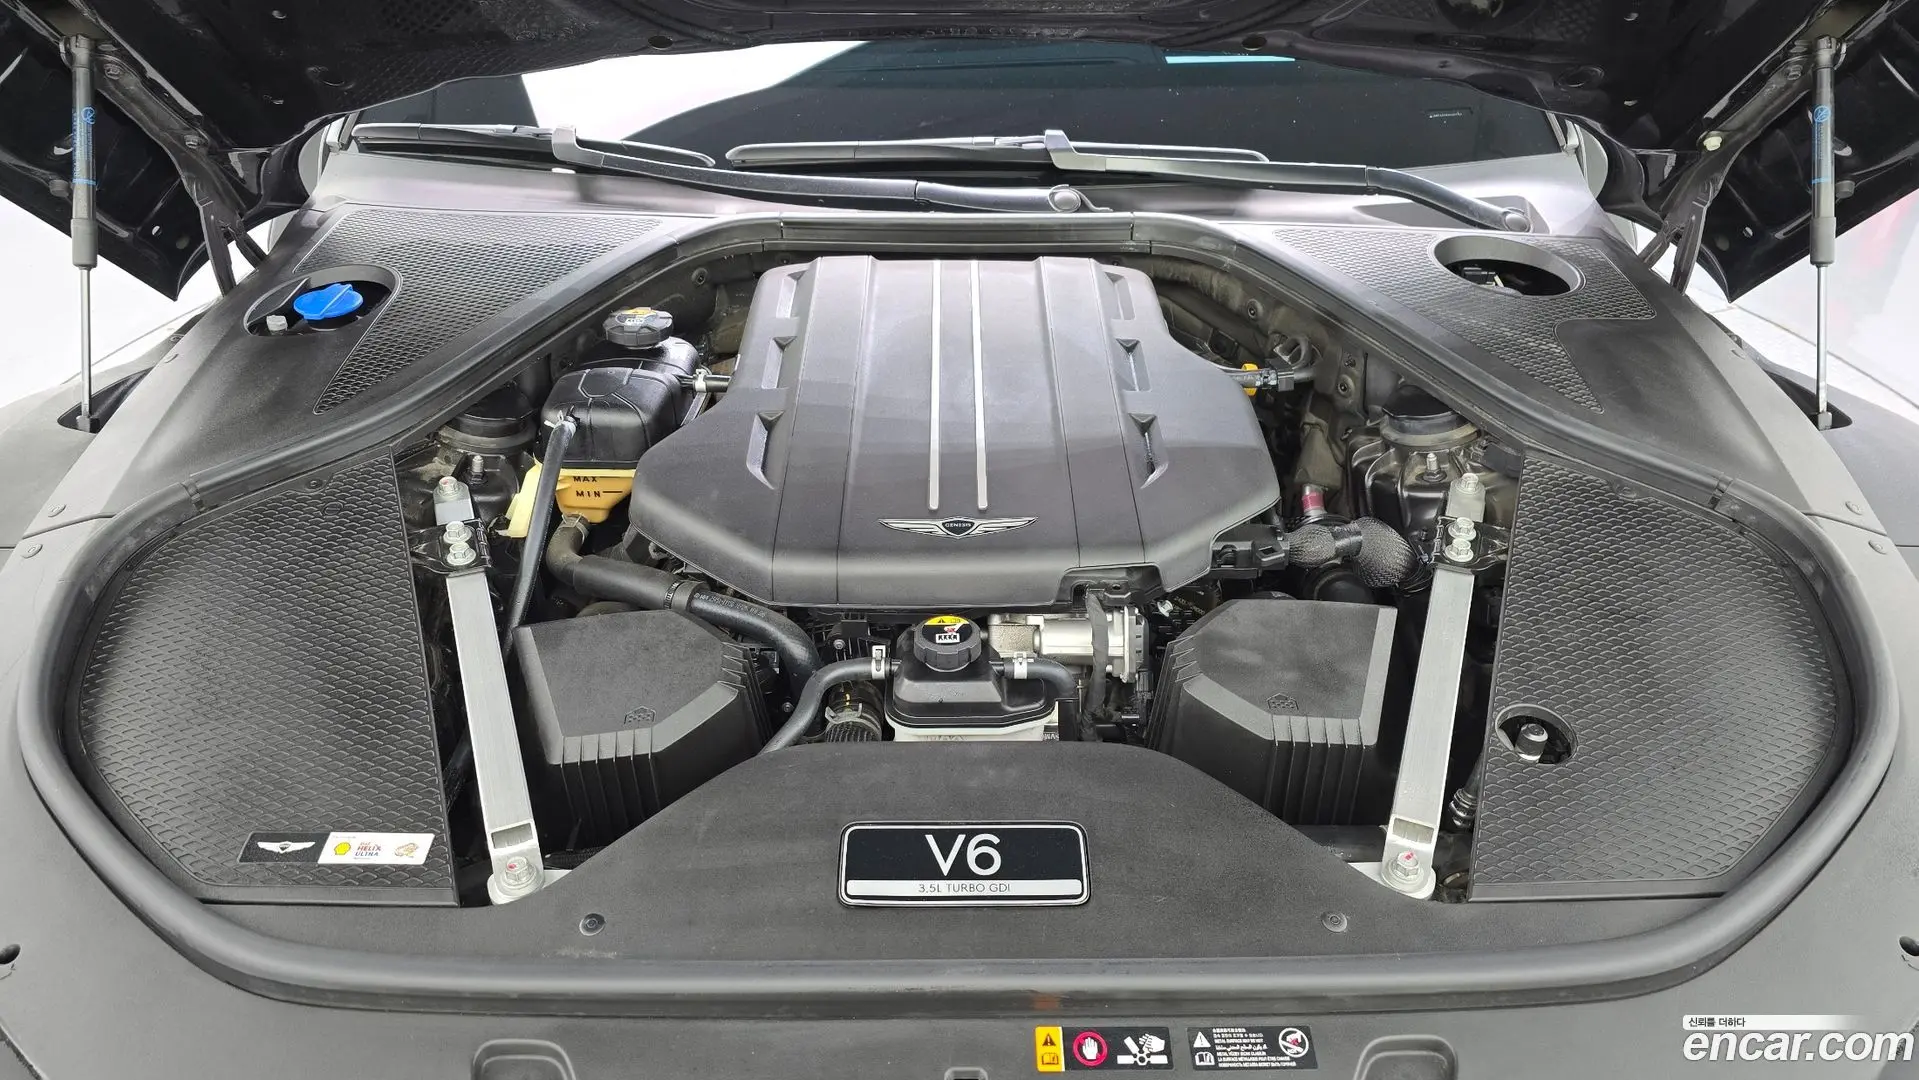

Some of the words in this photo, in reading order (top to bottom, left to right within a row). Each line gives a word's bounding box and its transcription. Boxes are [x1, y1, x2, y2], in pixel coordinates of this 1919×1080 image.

[576, 490, 601, 498] MIN
[357, 843, 382, 852] HELIX
[924, 833, 1002, 877] V6
[918, 883, 942, 893] 3.5L
[947, 883, 986, 893] TURBO
[989, 883, 1011, 893] GDI
